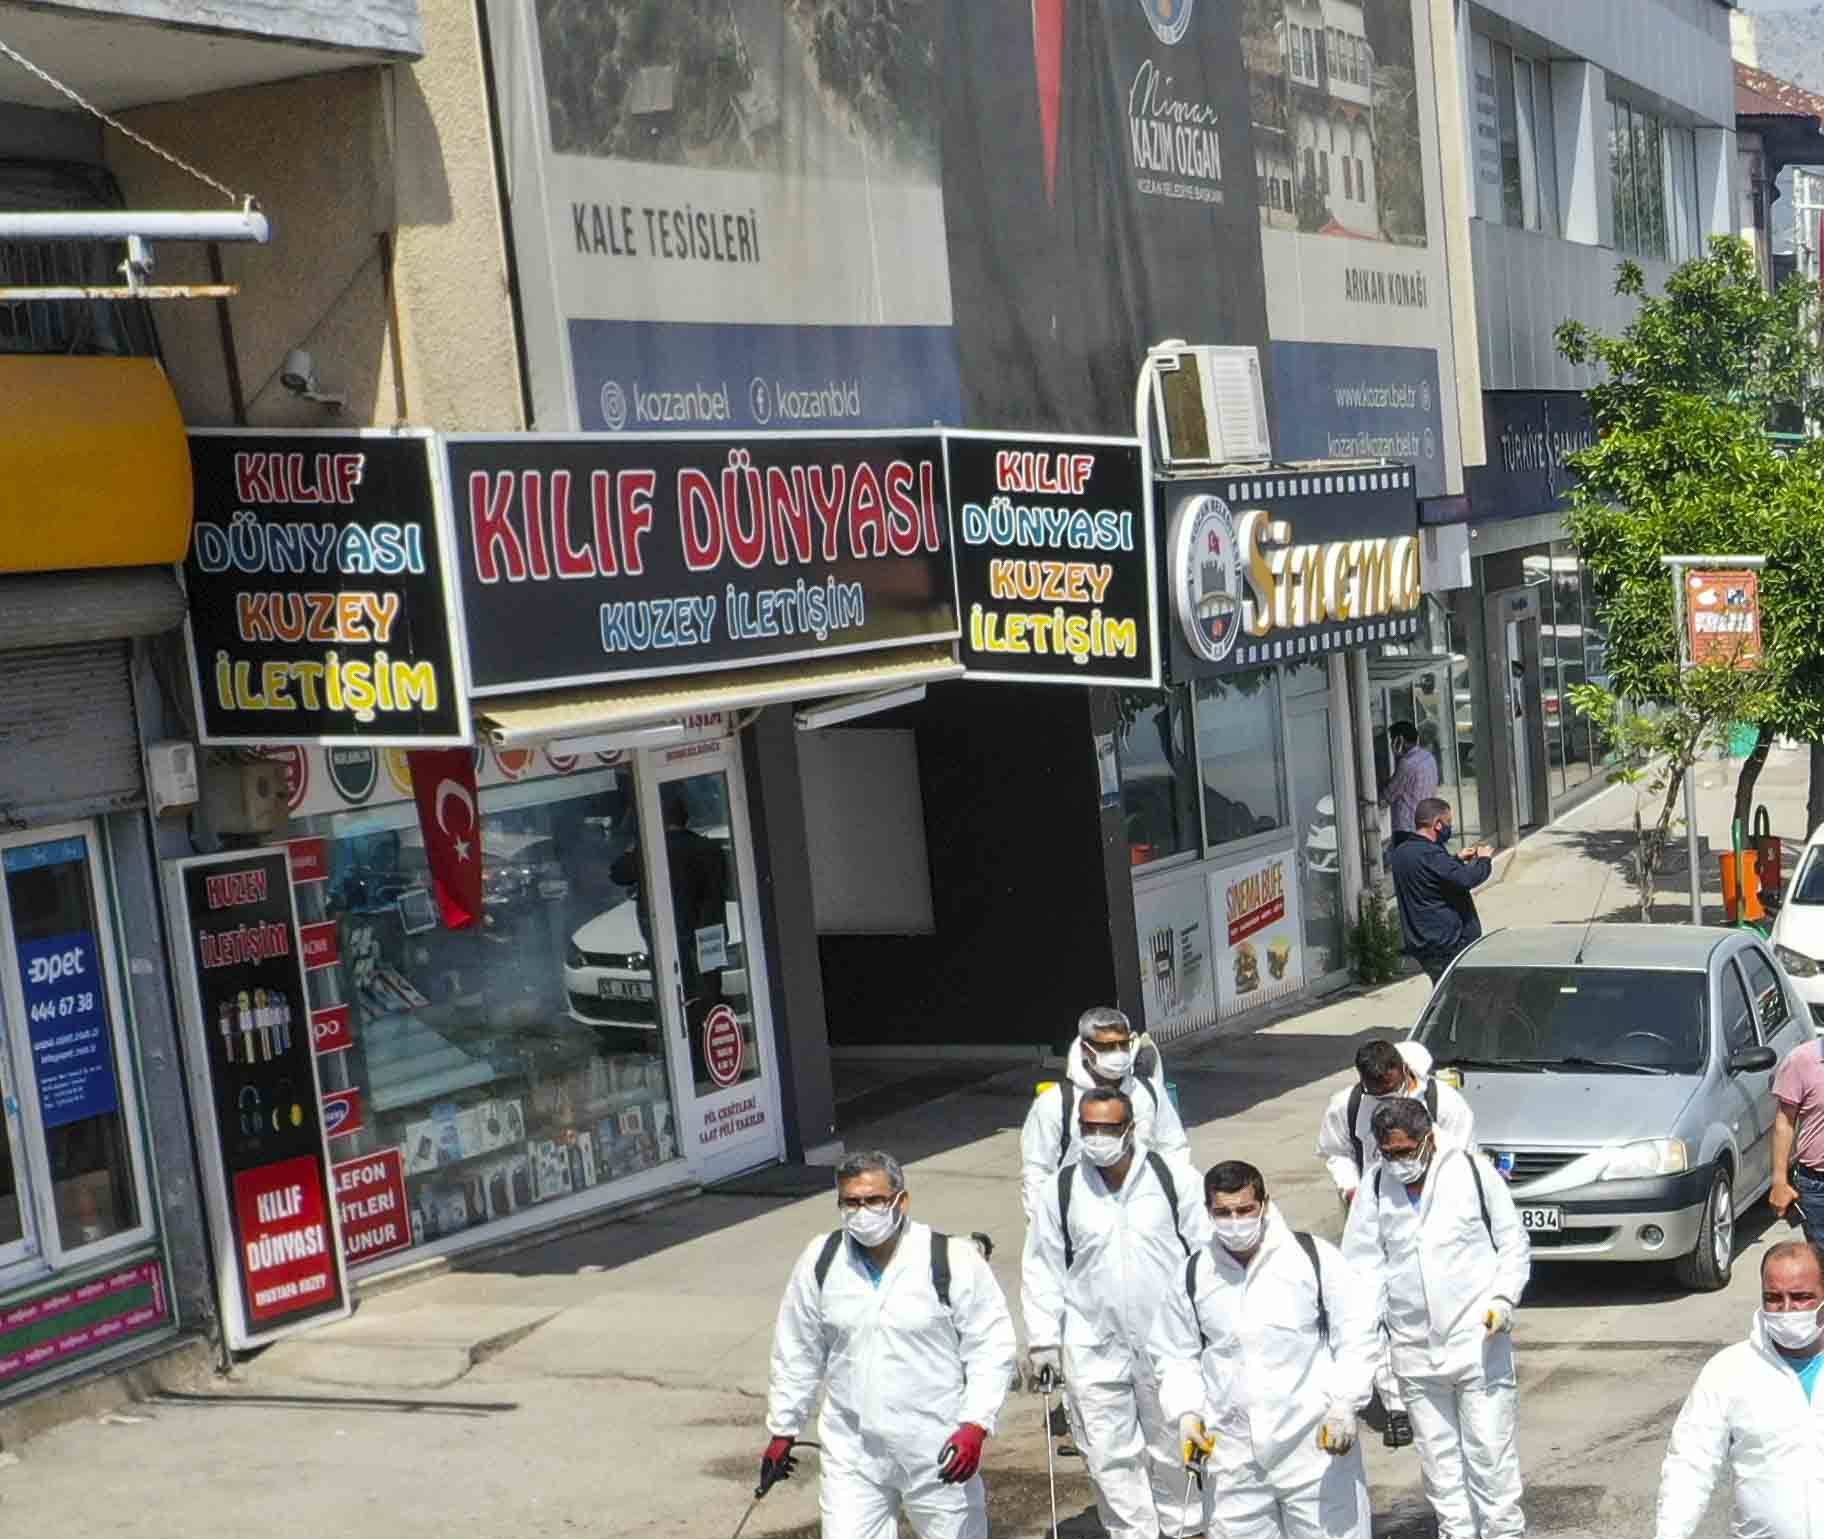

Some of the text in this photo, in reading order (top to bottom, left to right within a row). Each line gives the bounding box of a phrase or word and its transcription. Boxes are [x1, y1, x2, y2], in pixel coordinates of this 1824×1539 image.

[572, 203, 760, 263] KALE TESİSLERİ
[1345, 269, 1428, 309] ARIKAN KONAĞI
[633, 381, 861, 422] kozanbel kozanbld
[234, 453, 365, 503] KILIF
[996, 451, 1095, 495] KILIF
[469, 448, 940, 584] KILIF DÜNYASI
[962, 496, 1134, 551] DÜNYASI
[194, 511, 425, 573] DÜNYASI
[990, 559, 1113, 604] KUZEY
[1236, 510, 1421, 637] Sinema
[237, 592, 400, 642] KUZEY
[599, 574, 865, 653] KUZEY İLETİŞİM
[970, 603, 1137, 664] İLETİŞİM
[216, 650, 438, 722] İLETİŞİM
[206, 868, 268, 910] KUZEY
[28, 946, 86, 985] opet
[200, 919, 289, 969] İLETİŞİM
[31, 991, 94, 1023] 444 67 38
[256, 1184, 304, 1224] KILIF
[340, 1188, 396, 1223] İTLERİ
[1522, 1210, 1557, 1228] 834
[246, 1223, 325, 1273] DÜNYASI
